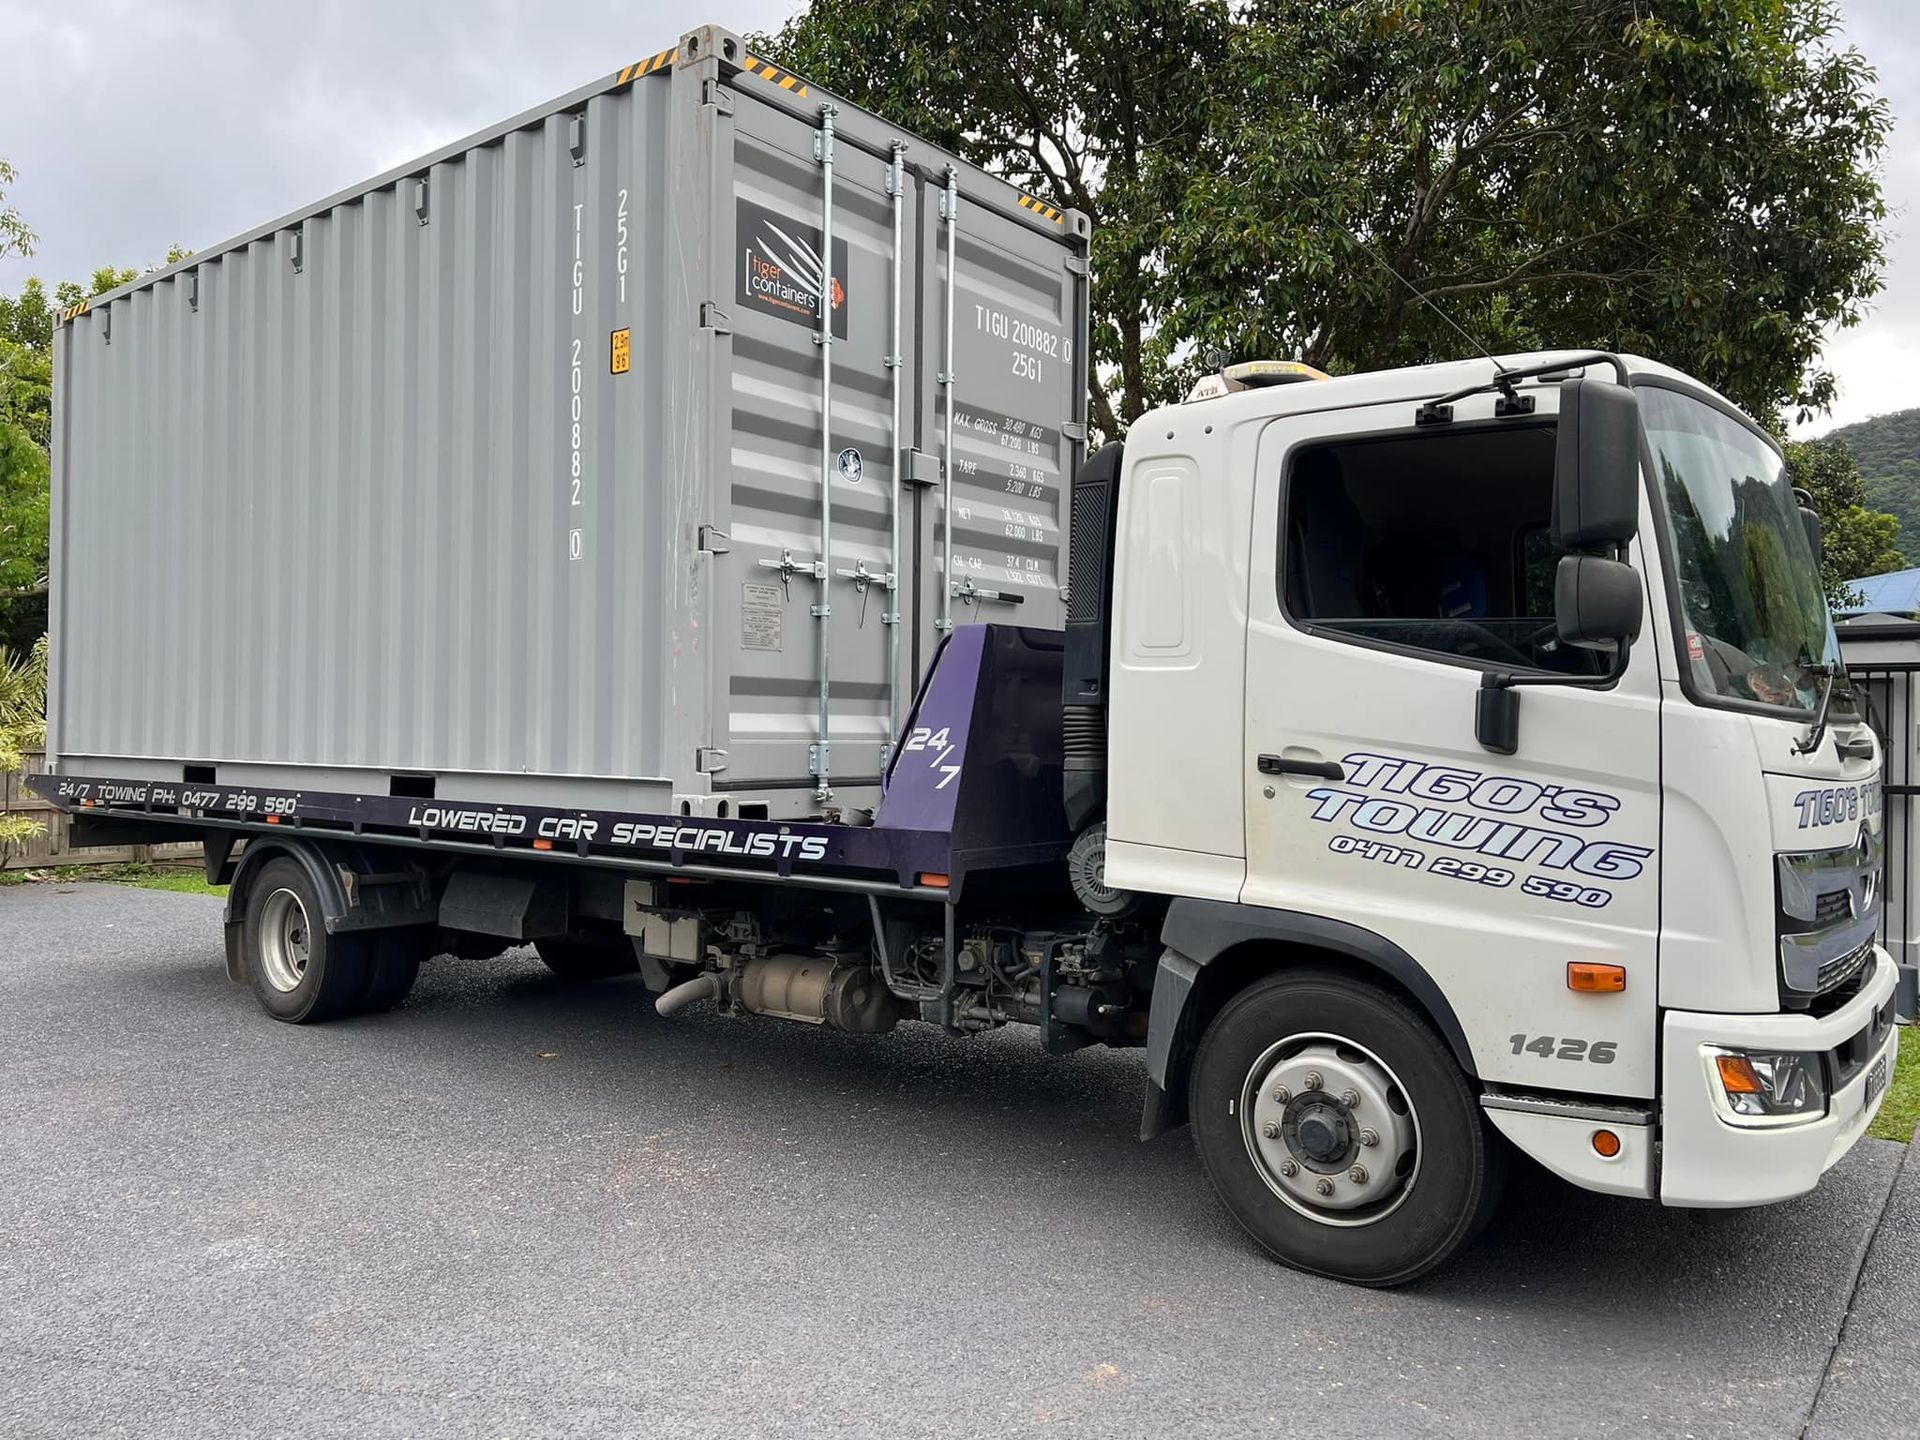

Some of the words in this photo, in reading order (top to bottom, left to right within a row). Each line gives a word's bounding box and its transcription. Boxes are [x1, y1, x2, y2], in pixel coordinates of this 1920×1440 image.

[572, 203, 583, 315] TIGU
[618, 189, 628, 302] 25G1
[752, 255, 782, 280] tiger
[752, 275, 816, 309] containers
[976, 304, 1008, 339] TIGU
[1012, 319, 1057, 358] 200882
[1063, 338, 1072, 363] 0
[1012, 351, 1042, 383] 25G1
[571, 339, 581, 505] 200882
[974, 418, 998, 435] GROSS
[1029, 425, 1044, 440] KGS
[1027, 440, 1040, 455] LBS
[958, 459, 978, 476] TARE
[1032, 469, 1045, 484] KGS
[1028, 484, 1043, 499] LBS
[571, 530, 581, 559] 0
[1031, 527, 1043, 542] LBS
[58, 782, 91, 797] 24/7
[98, 784, 147, 802] TOWING
[151, 790, 176, 805] PH:
[181, 791, 220, 808] 0477
[226, 794, 257, 812] 299
[264, 797, 298, 815] 590
[1341, 752, 1621, 828] TIGO'S
[1794, 786, 1858, 829] TIGO'S
[408, 806, 527, 836] LOWERED
[537, 817, 599, 841] CAR
[610, 822, 830, 861] SPECIALISTS
[1305, 787, 1655, 880] TOWING
[1328, 835, 1426, 869] 0477
[1427, 856, 1515, 888] 299
[1521, 875, 1612, 909] 590
[1509, 1033, 1618, 1065] 1426
